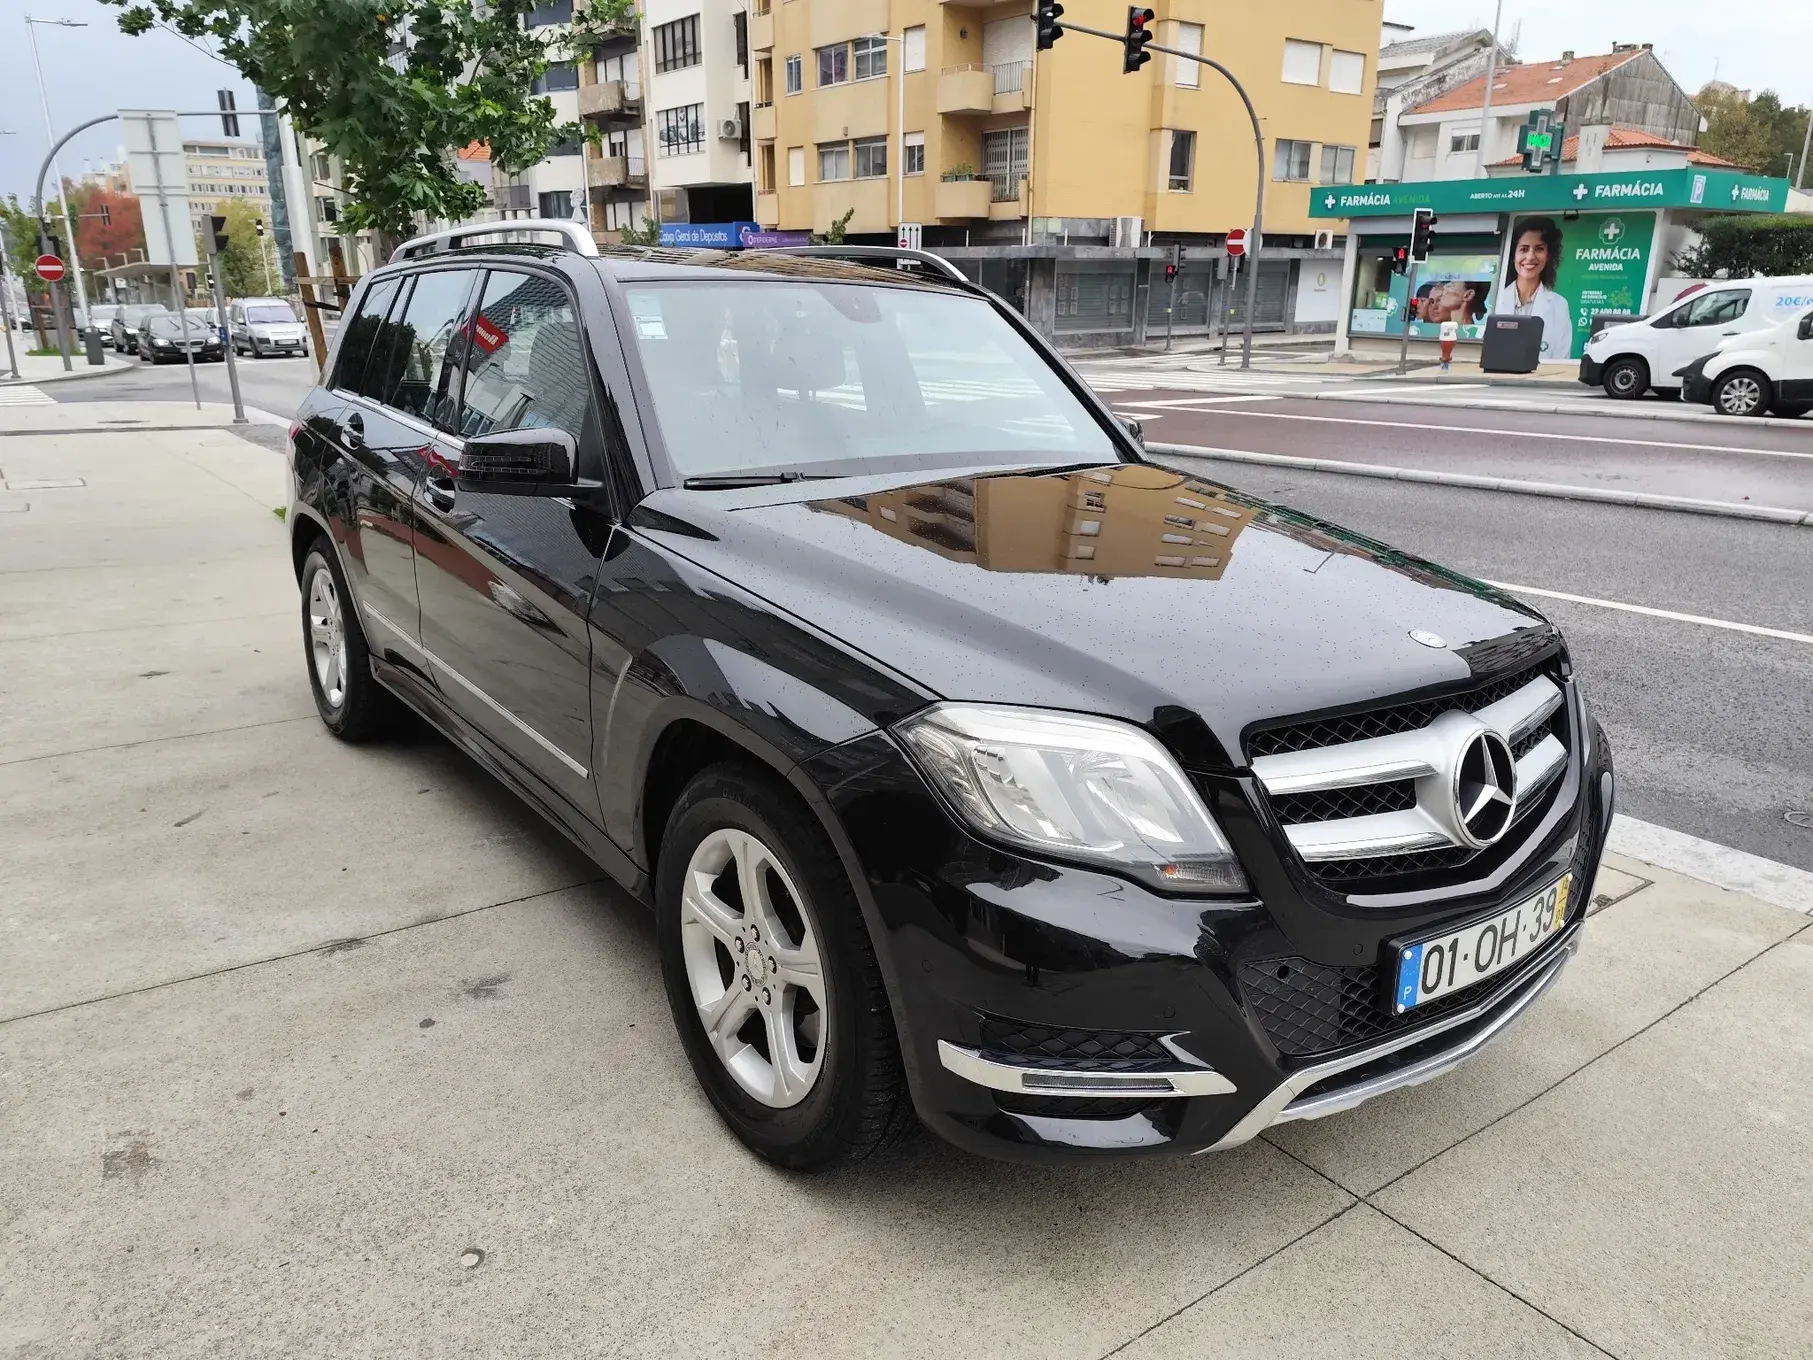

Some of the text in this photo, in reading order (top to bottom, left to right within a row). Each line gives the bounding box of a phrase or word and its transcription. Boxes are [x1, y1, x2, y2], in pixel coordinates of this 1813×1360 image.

[1470, 192, 1493, 200] ABERTO
[1508, 189, 1525, 199] 24H
[1595, 180, 1664, 198] FARMÁCIA
[1741, 186, 1769, 201] FARMÁCIA
[1340, 192, 1391, 207] FARMÁCIA
[659, 230, 675, 244] Caixa
[675, 229, 691, 242] Geral
[691, 230, 699, 242] de
[1575, 246, 1641, 260] FARMÁCIA
[1588, 263, 1623, 271] AVENIDA
[1403, 985, 1413, 1000] P
